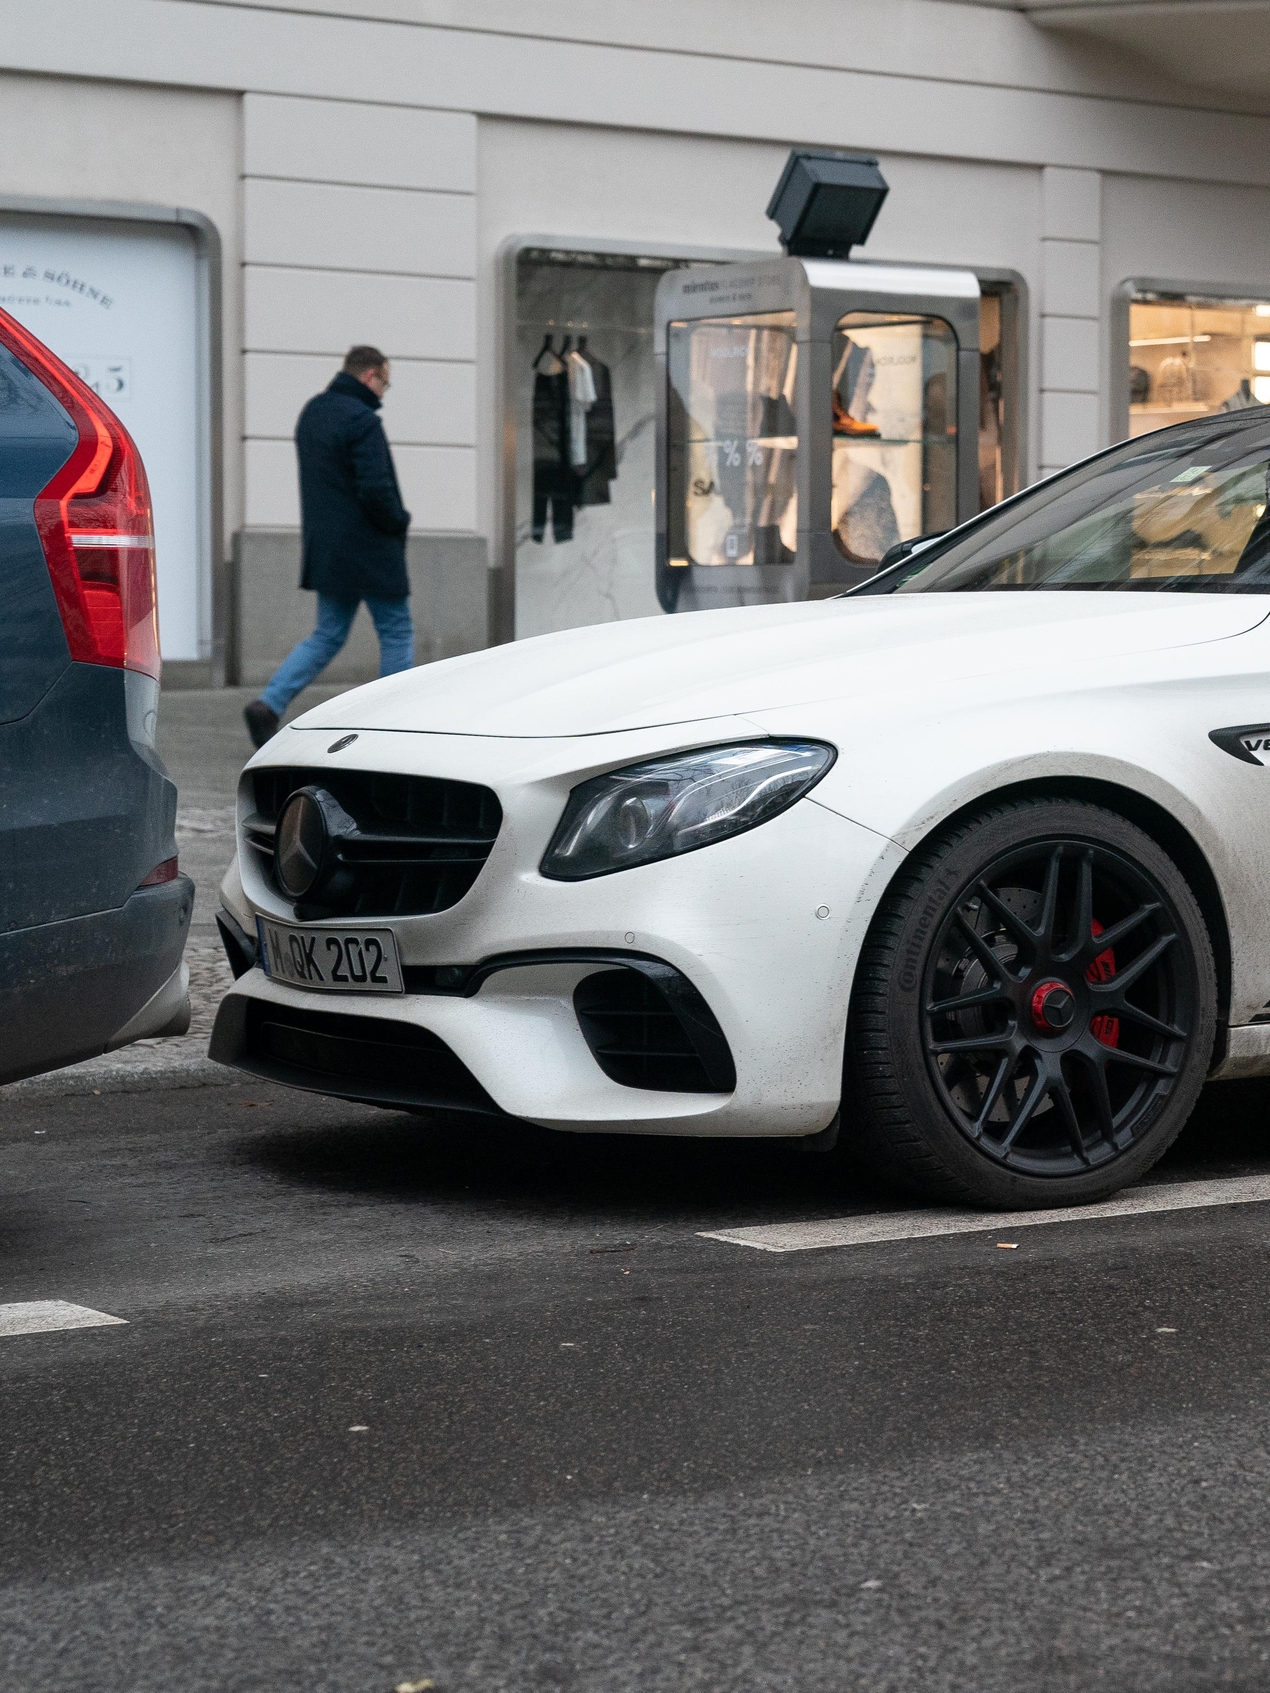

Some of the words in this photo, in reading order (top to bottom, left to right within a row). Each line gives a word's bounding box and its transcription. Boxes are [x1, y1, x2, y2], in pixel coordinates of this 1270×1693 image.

[42, 270, 114, 310] SÖHNE
[288, 934, 325, 982] QK
[325, 936, 389, 984] 202
[897, 876, 952, 993] Continental
